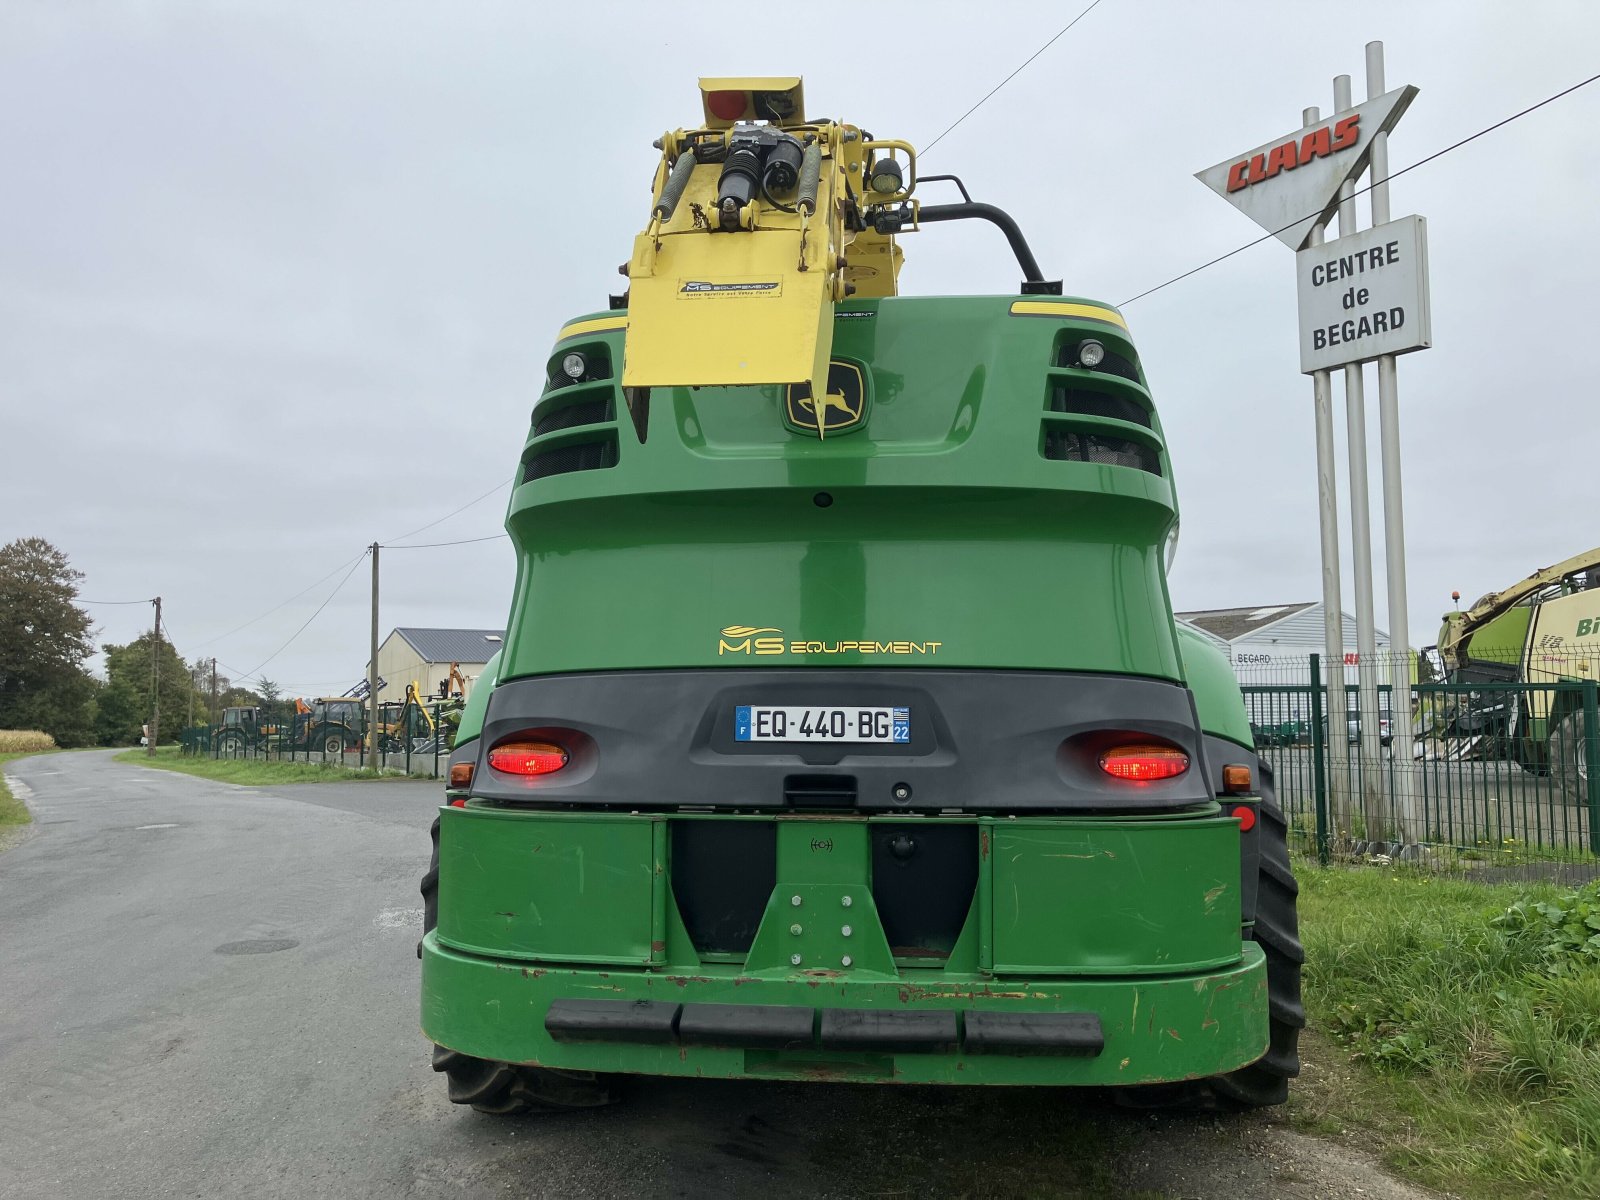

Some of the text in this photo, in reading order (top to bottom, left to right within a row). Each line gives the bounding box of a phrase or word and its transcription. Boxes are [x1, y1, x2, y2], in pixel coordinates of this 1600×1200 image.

[1226, 113, 1361, 193] CLAAS
[1311, 240, 1400, 287] CENTRE
[1342, 286, 1370, 310] de
[1313, 306, 1405, 351] BEGARD
[718, 637, 942, 656] MS EQUIPEMENT
[1237, 653, 1271, 664] BEGARD
[740, 726, 746, 735] F
[894, 726, 909, 740] 22
